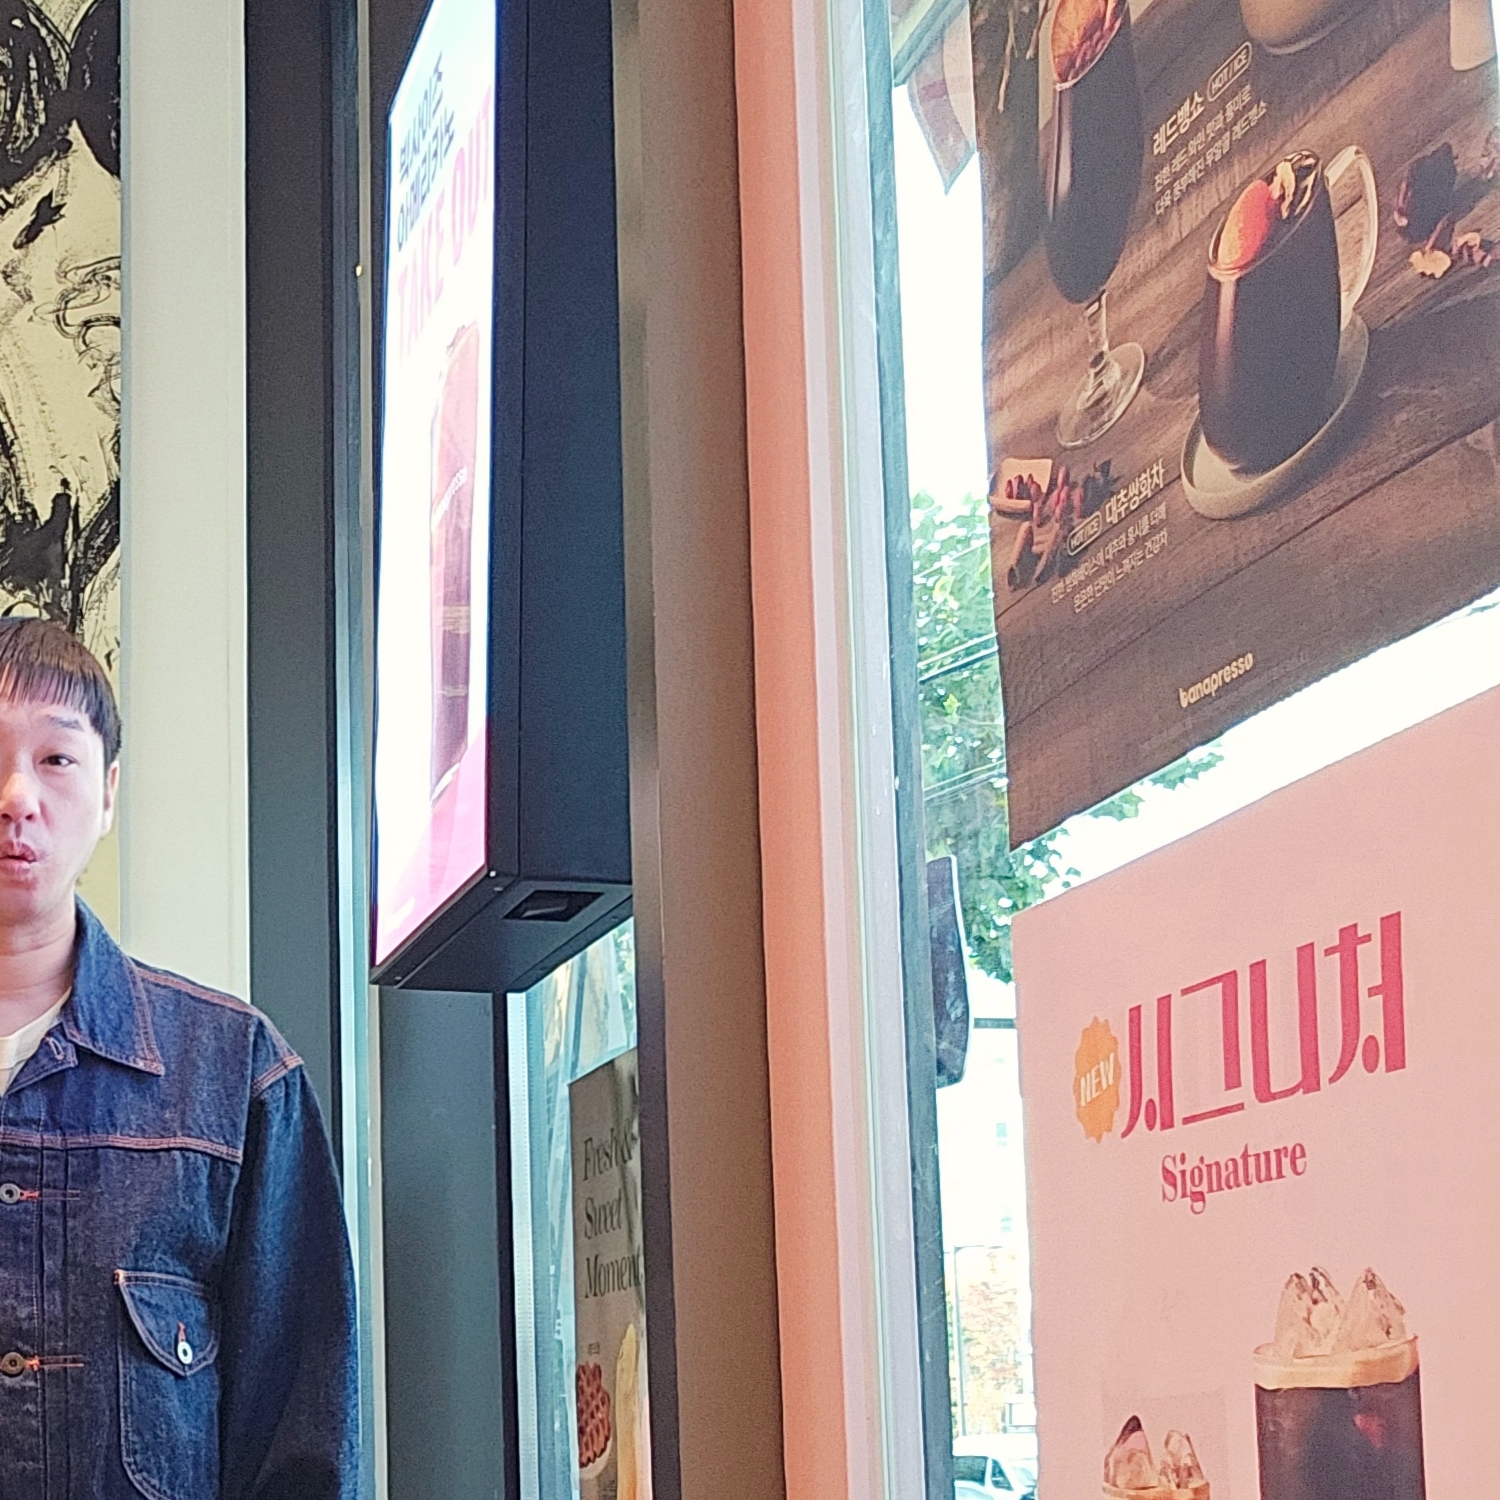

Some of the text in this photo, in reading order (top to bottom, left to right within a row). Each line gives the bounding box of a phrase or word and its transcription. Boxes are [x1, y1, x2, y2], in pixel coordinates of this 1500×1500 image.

[1153, 91, 1205, 155] 레드뱅쇼
[1232, 100, 1267, 141] 레드뱅쇼
[397, 106, 454, 252] 아메리카노
[398, 84, 491, 360] TAKE OUT
[1105, 458, 1165, 525] 대추쌍화차
[1178, 652, 1254, 708] banapresso
[1120, 911, 1406, 1139] 시그니처
[1080, 1052, 1115, 1107] NEW
[583, 1128, 619, 1181] Fresh
[1161, 1143, 1307, 1215] Signature
[584, 1188, 622, 1240] Sweet
